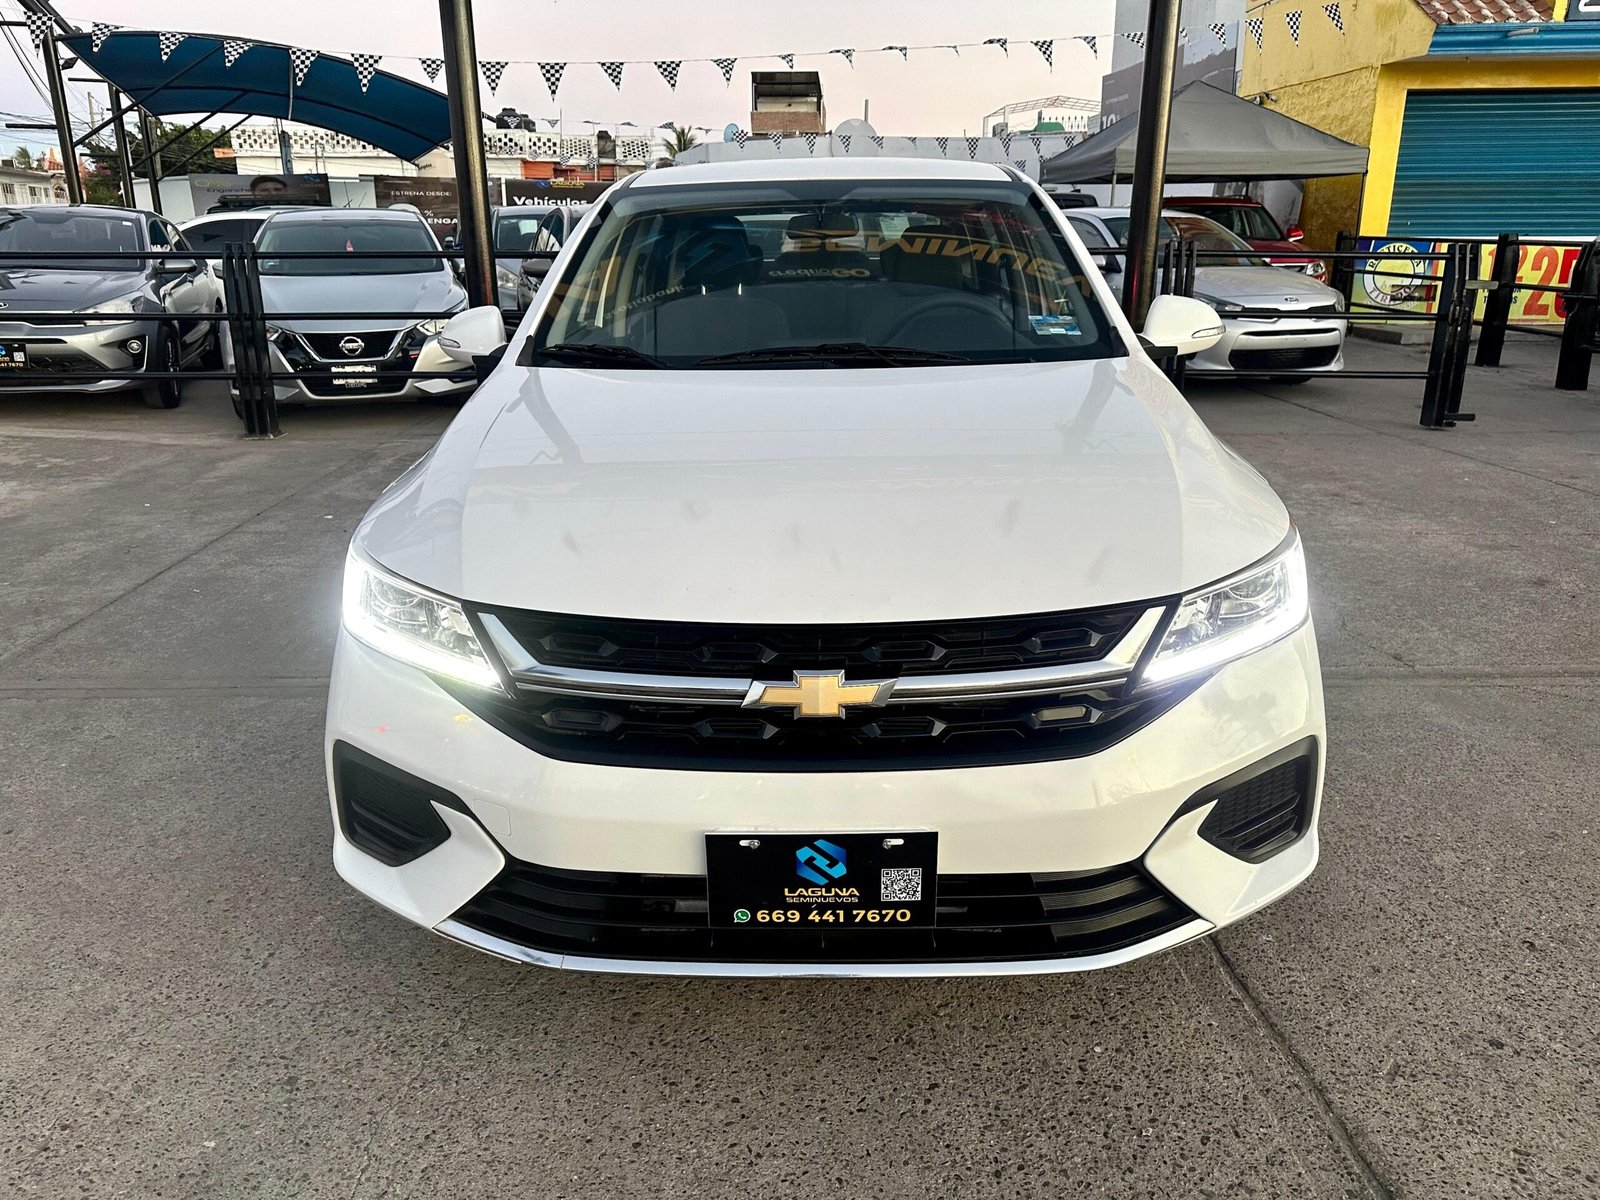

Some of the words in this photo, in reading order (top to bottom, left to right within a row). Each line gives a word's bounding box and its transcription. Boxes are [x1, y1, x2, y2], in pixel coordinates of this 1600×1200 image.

[513, 196, 588, 206] Vehículos
[784, 887, 860, 897] LAGUNA
[756, 909, 800, 923] 669
[807, 909, 844, 923] 441
[852, 908, 911, 923] 7670
